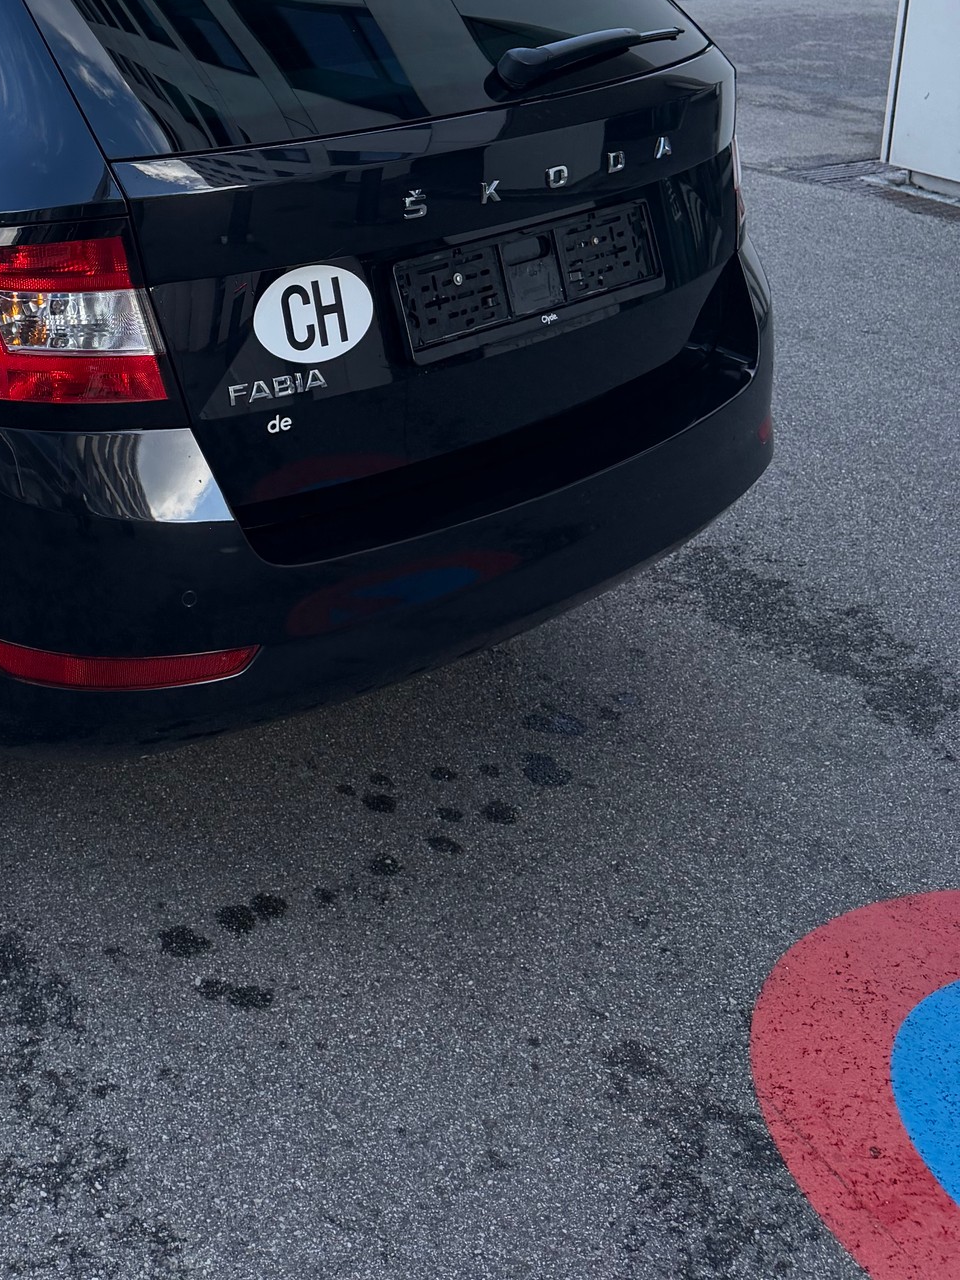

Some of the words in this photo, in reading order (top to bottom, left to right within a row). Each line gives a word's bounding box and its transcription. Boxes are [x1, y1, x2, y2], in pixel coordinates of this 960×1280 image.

[402, 136, 672, 220] ŠKODA
[280, 276, 349, 351] CH
[228, 369, 328, 407] FABIA
[267, 414, 293, 434] de
